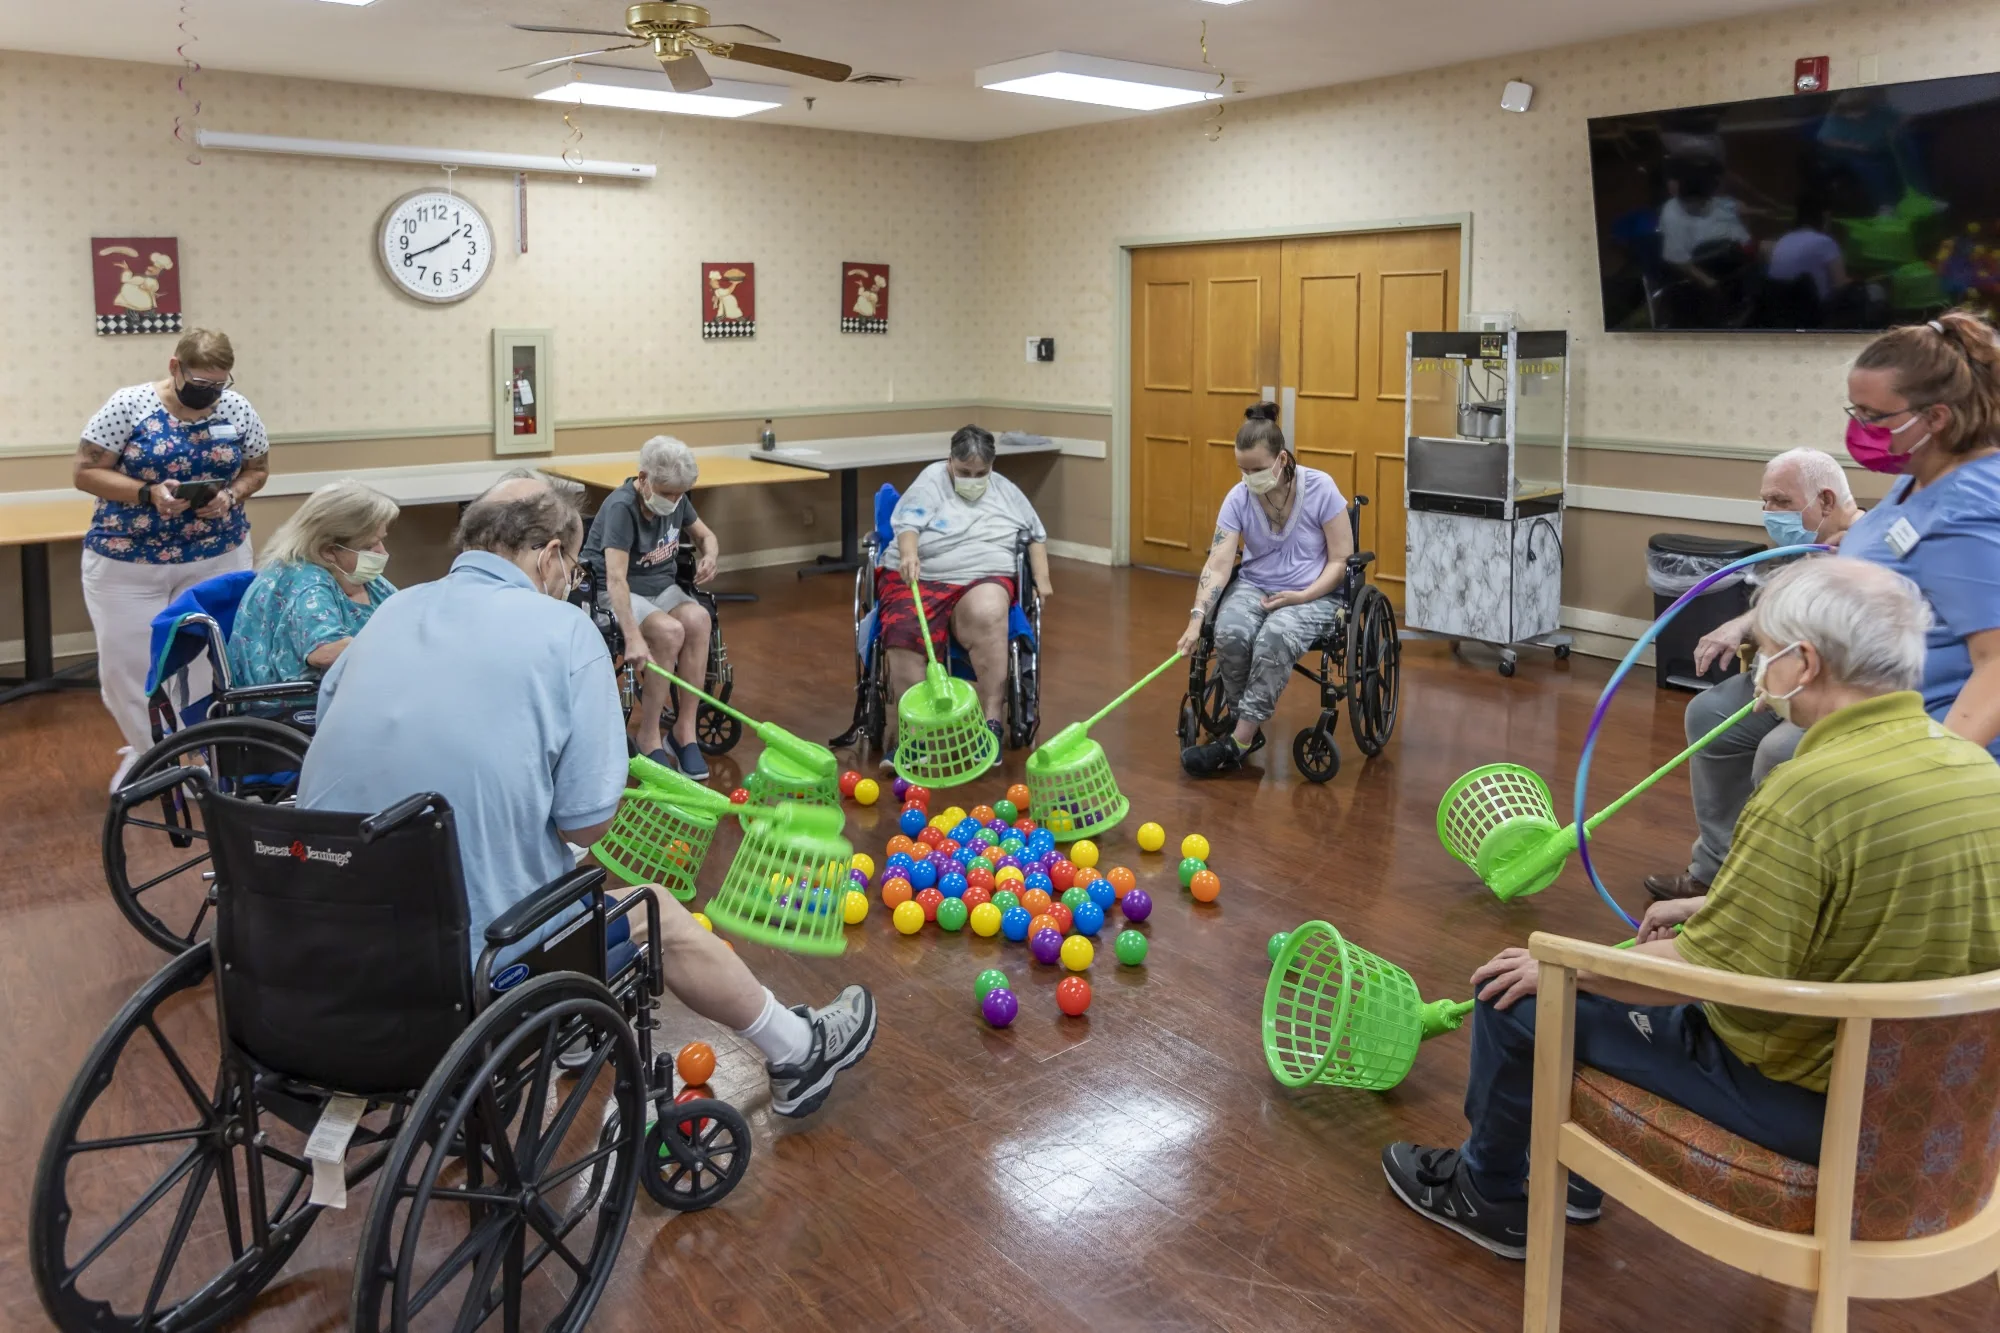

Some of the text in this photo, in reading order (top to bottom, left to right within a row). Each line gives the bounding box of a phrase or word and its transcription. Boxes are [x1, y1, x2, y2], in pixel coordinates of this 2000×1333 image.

[416, 206, 428, 222] 11
[431, 204, 448, 220] 12
[453, 211, 460, 226] 1
[402, 218, 417, 234] 10
[463, 223, 473, 238] 2
[400, 235, 409, 250] 9
[467, 241, 476, 255] 3
[403, 253, 413, 267] 8
[462, 258, 471, 272] 4
[417, 265, 427, 280] 7
[433, 271, 442, 286] 6
[450, 268, 459, 283] 5
